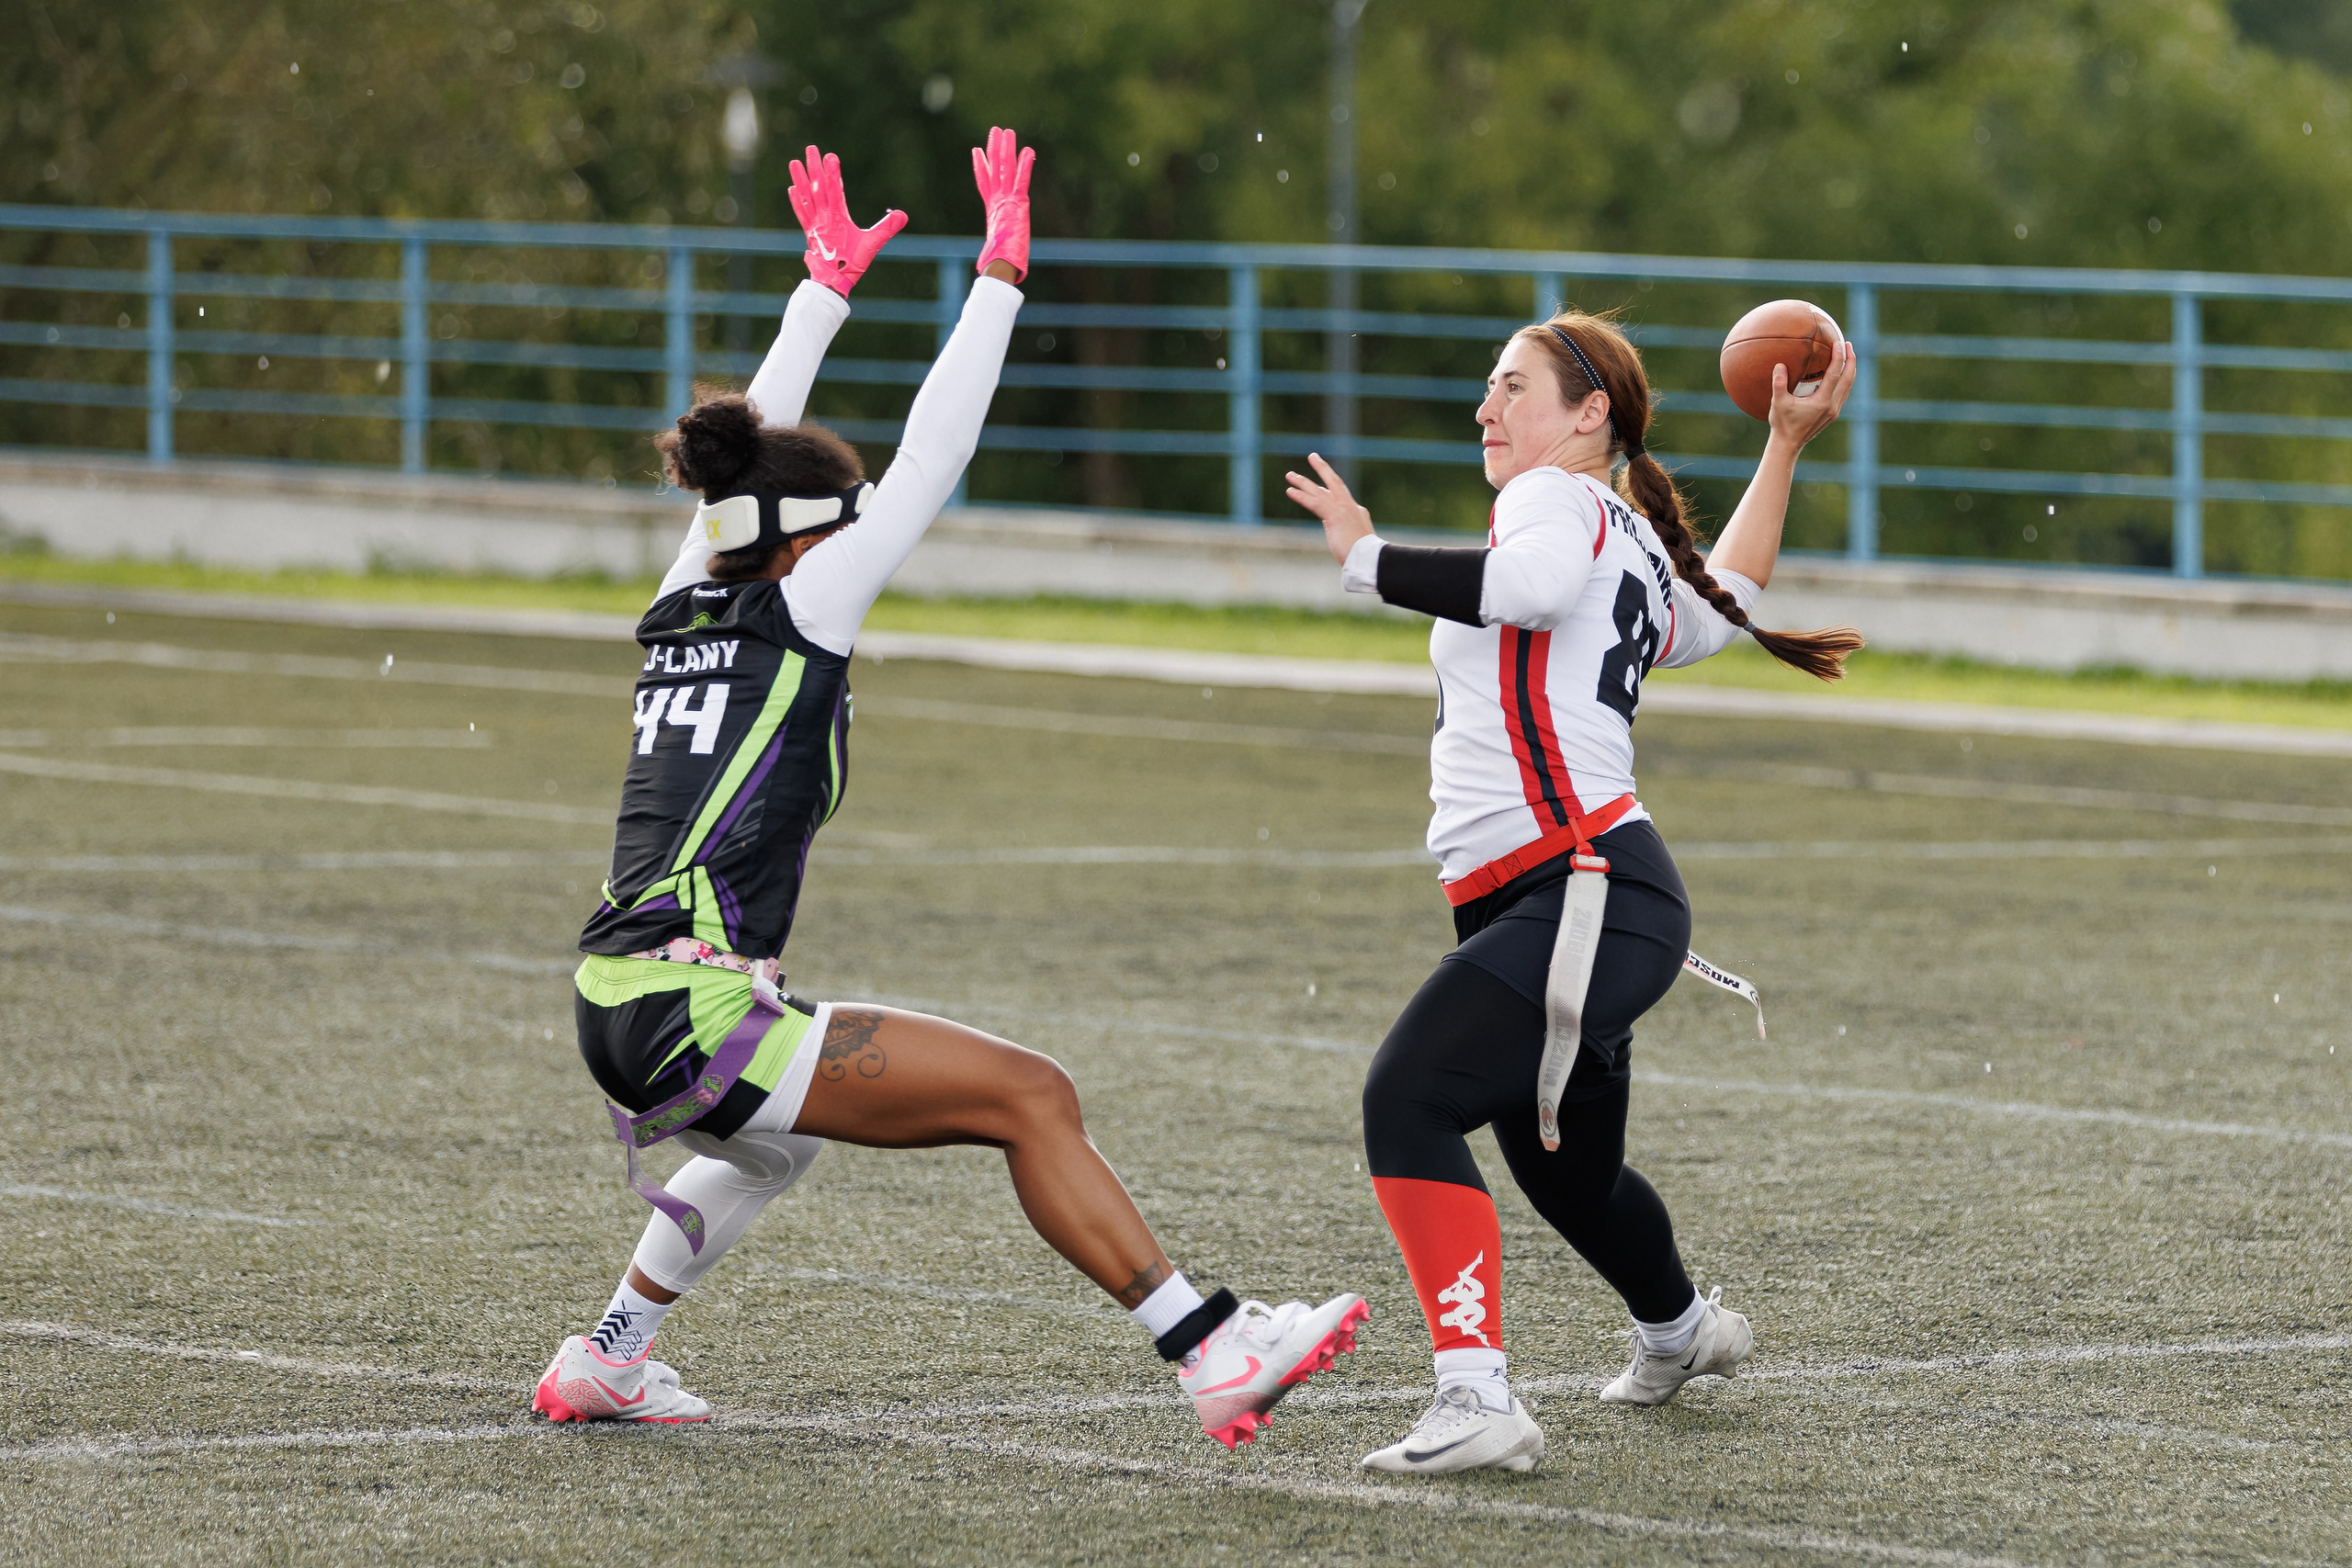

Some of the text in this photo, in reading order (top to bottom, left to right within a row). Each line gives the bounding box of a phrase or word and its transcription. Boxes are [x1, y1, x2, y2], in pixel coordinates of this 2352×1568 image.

[643, 640, 741, 673] J-LANY
[632, 682, 731, 755] 44
[1686, 953, 1740, 989] MOSC
